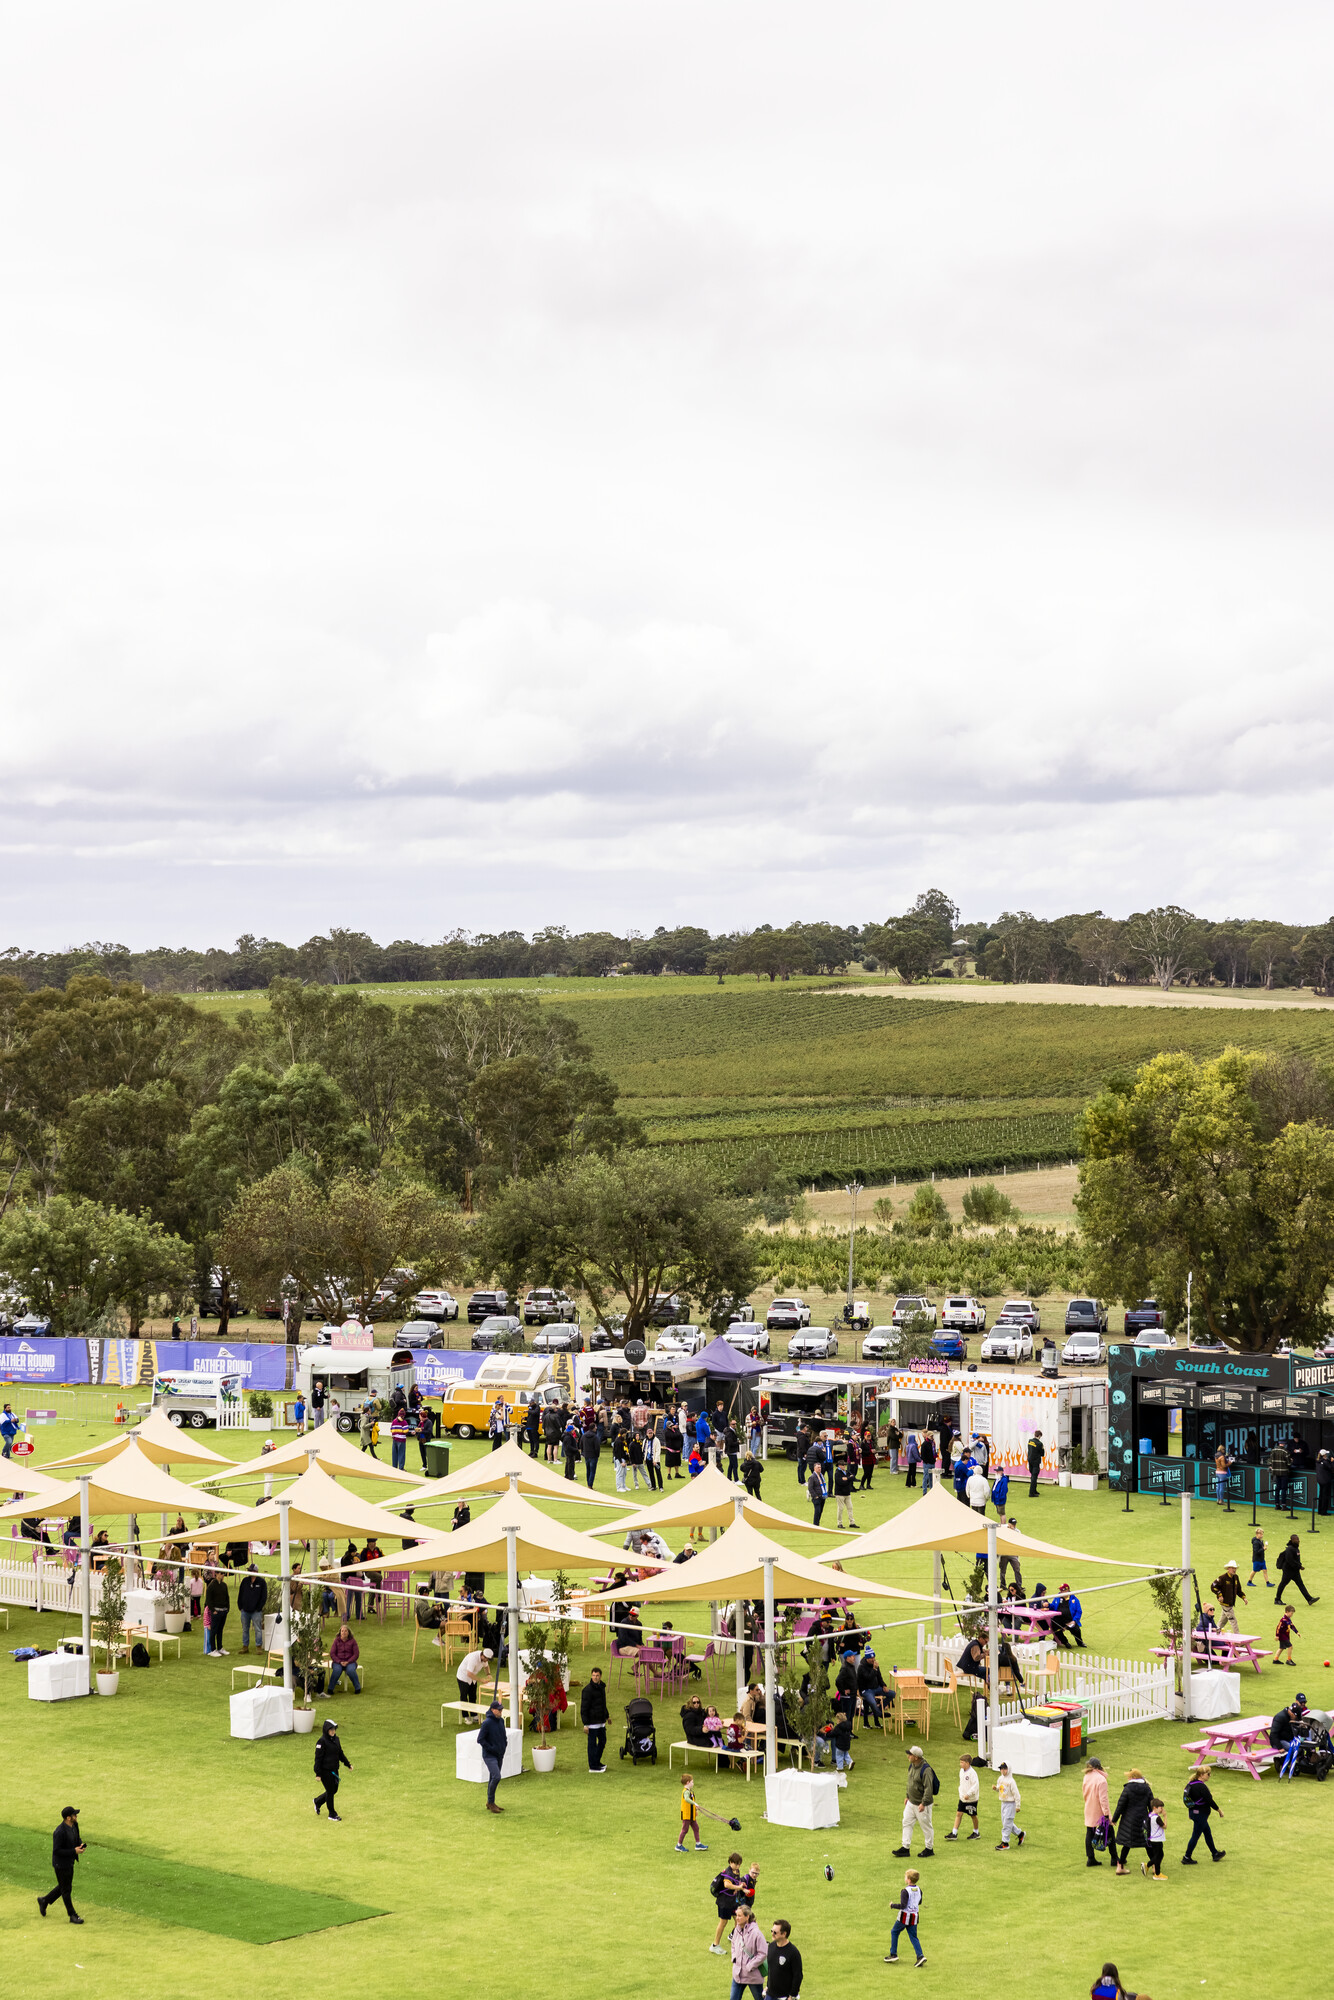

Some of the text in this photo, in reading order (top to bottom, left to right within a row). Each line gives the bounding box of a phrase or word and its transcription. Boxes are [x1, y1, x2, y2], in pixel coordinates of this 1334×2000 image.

[333, 1336, 372, 1346] ICE CREAM
[27, 1353, 55, 1368] ROUND
[193, 1358, 252, 1374] GATHER ROUND
[1175, 1359, 1270, 1378] South Coast
[555, 1353, 571, 1394] OUND
